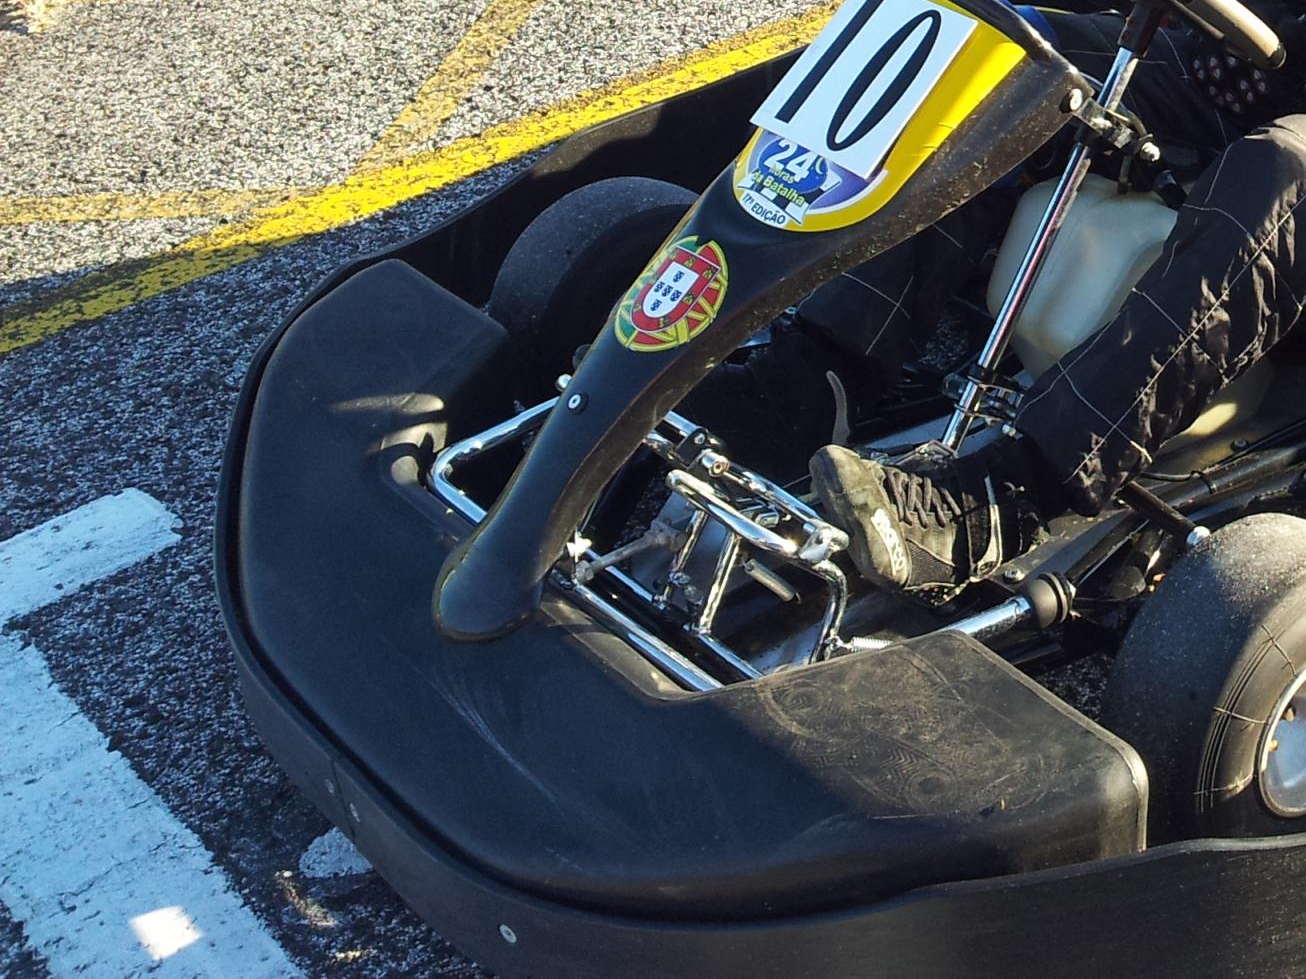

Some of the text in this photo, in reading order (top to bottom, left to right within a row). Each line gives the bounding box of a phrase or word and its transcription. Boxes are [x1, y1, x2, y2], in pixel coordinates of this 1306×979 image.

[763, 137, 820, 182] 24
[763, 175, 807, 208] Batalha
[750, 201, 787, 226] EDIÇÃO
